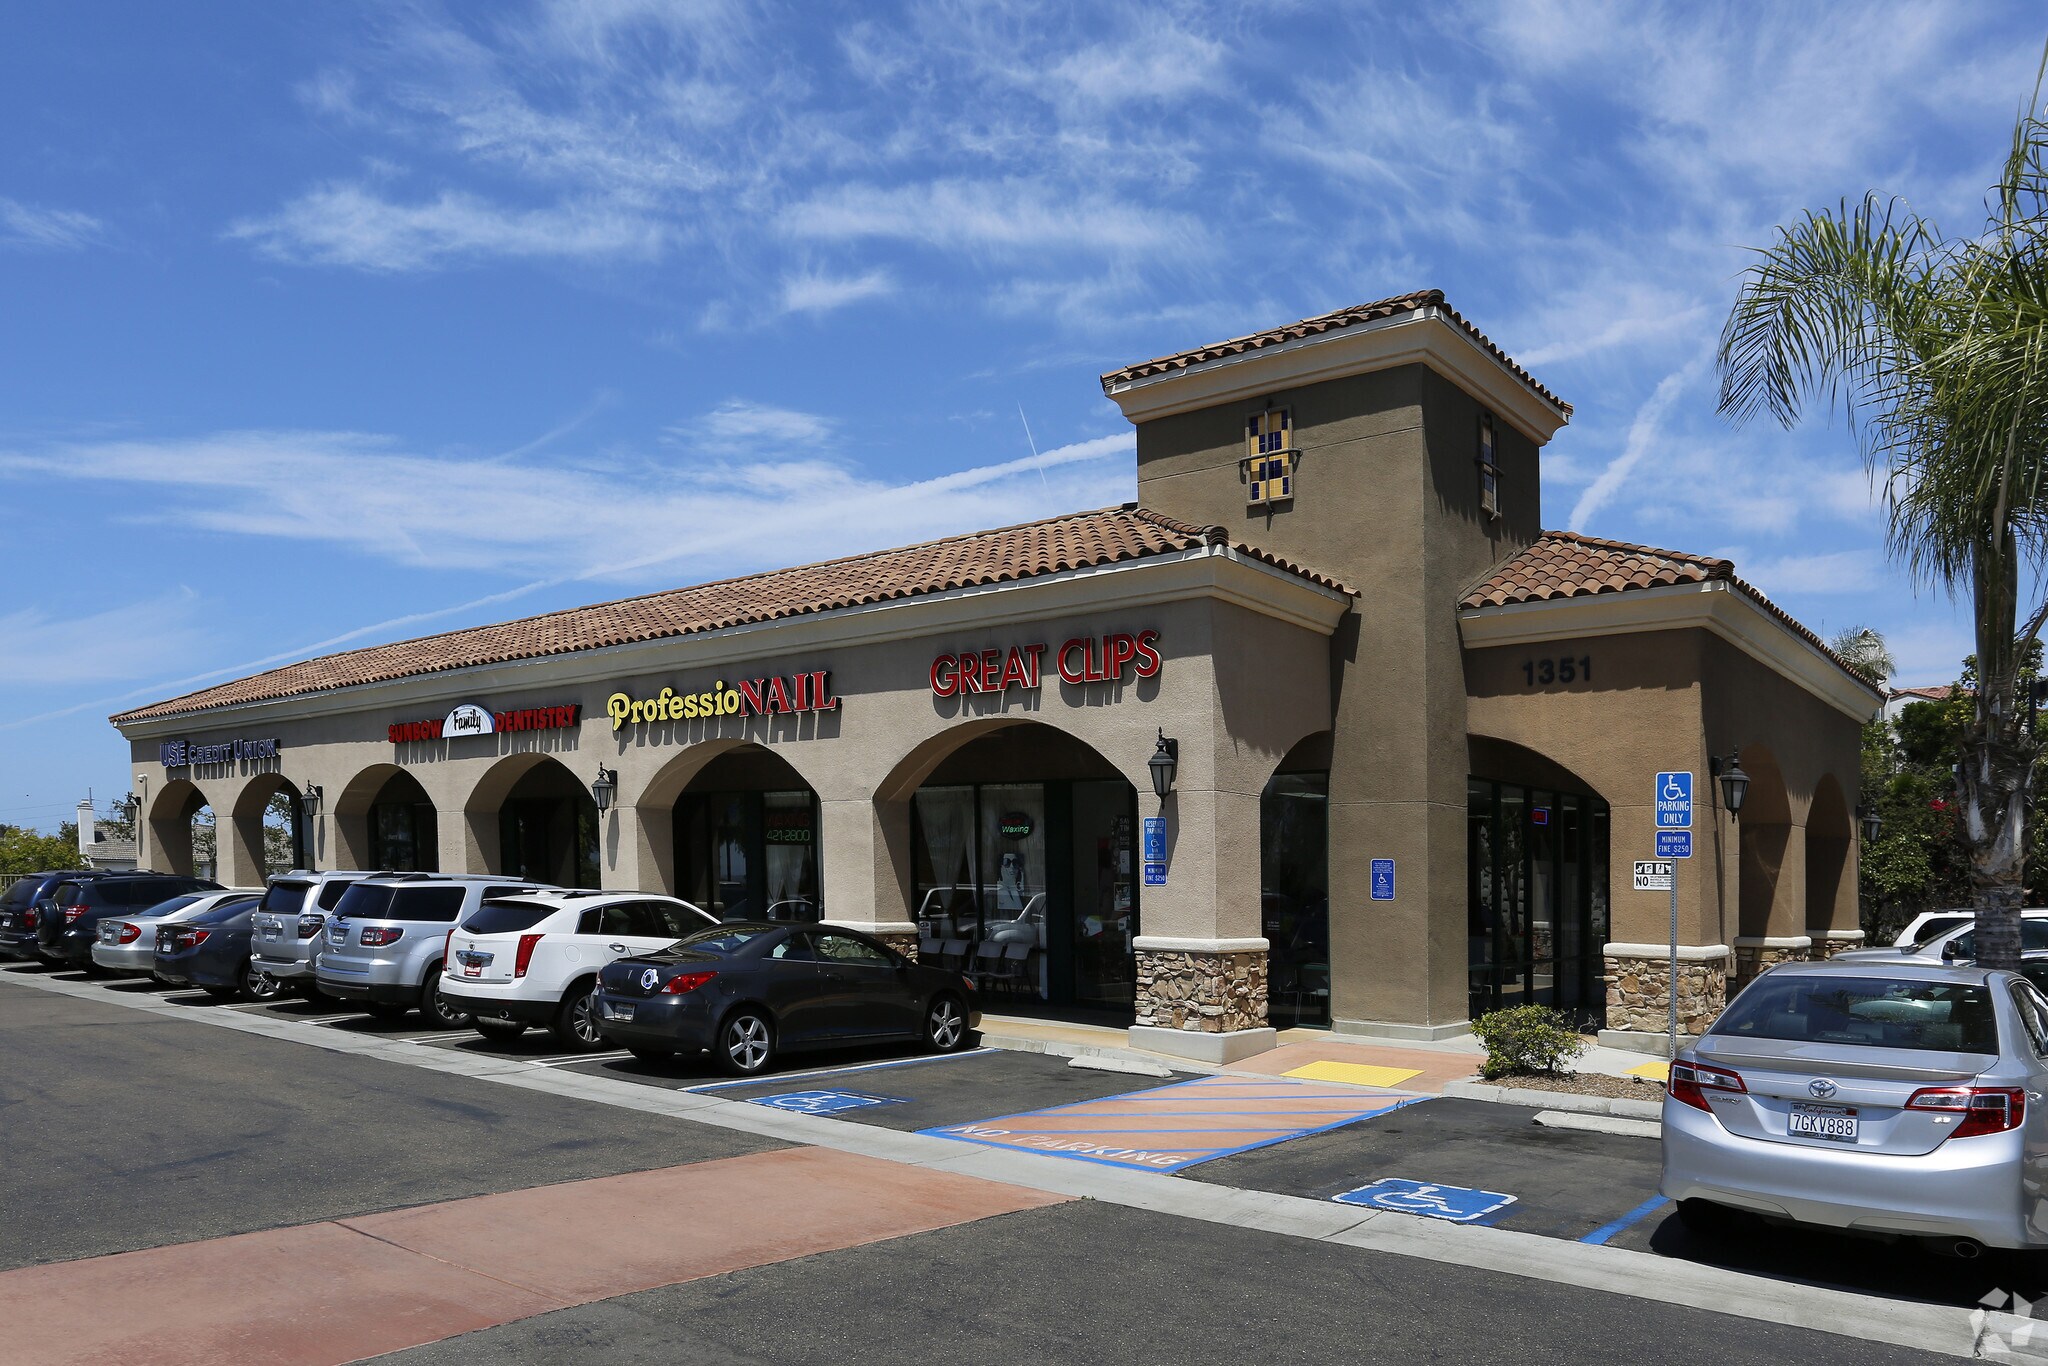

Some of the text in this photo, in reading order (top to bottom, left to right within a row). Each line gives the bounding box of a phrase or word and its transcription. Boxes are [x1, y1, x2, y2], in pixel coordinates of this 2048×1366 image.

[929, 629, 1163, 697] GREAT CLIPS
[1522, 655, 1590, 686] 1351
[607, 670, 837, 731] ProfessioNAIL
[388, 703, 577, 743] SUNBOW Family DENTISTRY
[159, 738, 277, 767] USE CREDIT UNION
[1658, 800, 1690, 811] PARKING
[1001, 824, 1030, 834] Waxing
[1663, 813, 1684, 824] ONLY
[1658, 845, 1689, 853] FINE $250
[1635, 876, 1649, 887] NO
[1803, 1104, 1842, 1116] California
[1793, 1114, 1854, 1136] 7GKV888
[949, 1125, 1188, 1164] NO PARKING
